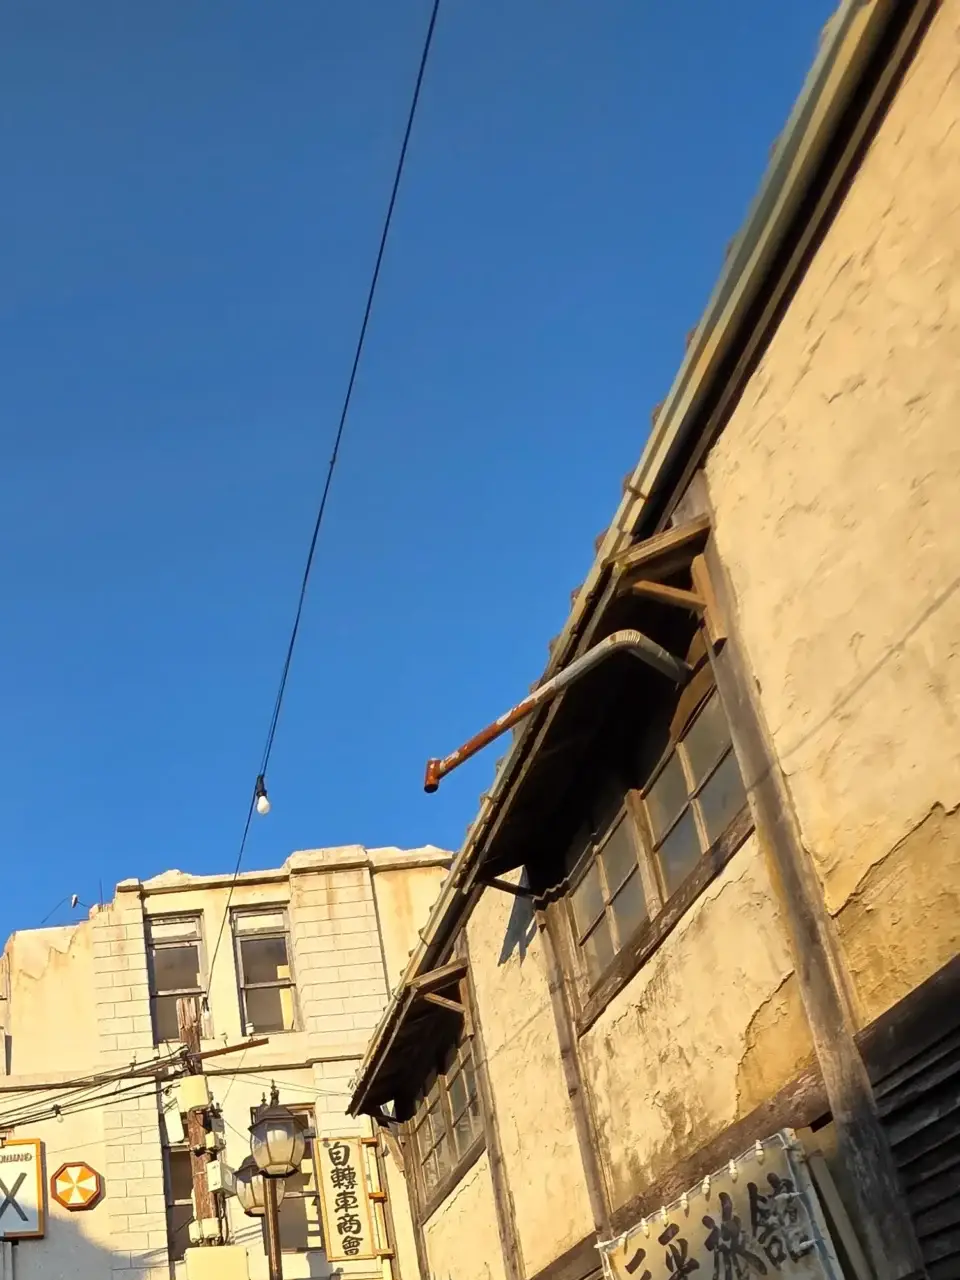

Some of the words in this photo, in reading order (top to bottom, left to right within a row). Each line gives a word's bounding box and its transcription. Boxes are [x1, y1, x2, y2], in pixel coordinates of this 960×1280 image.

[328, 1142, 364, 1256] 自轉車商會
